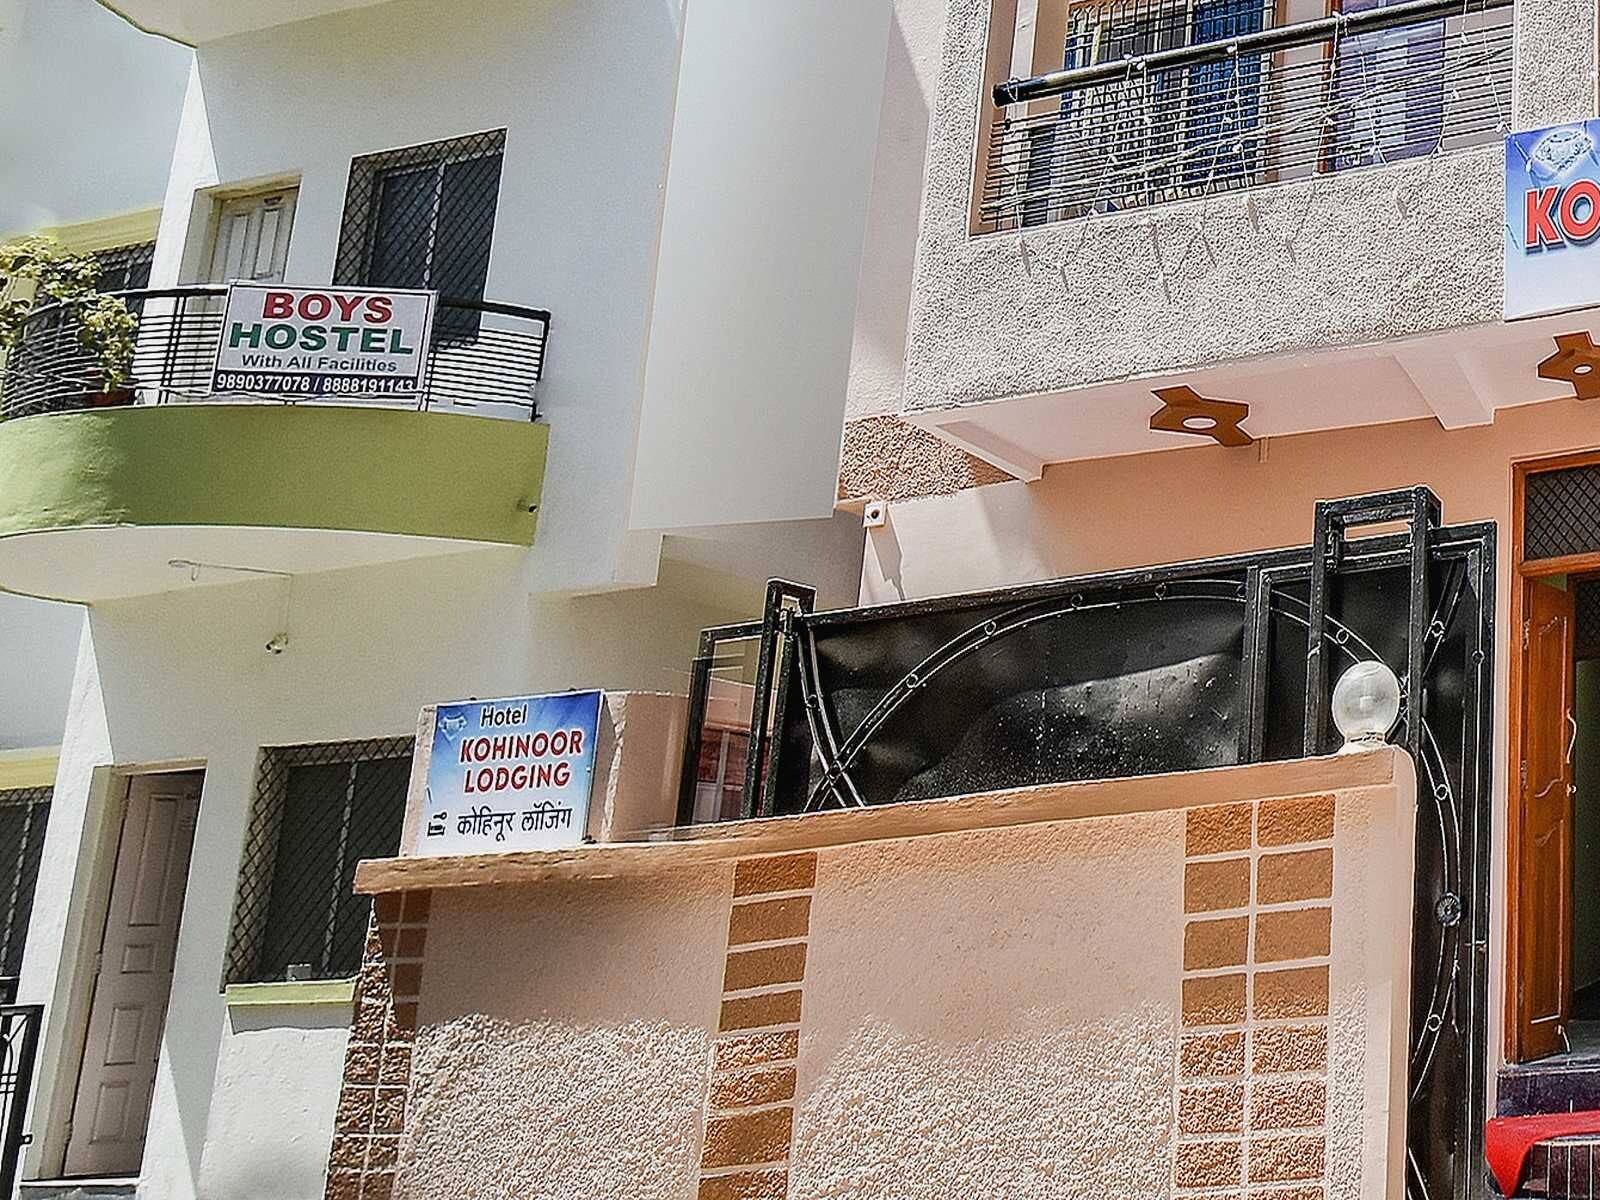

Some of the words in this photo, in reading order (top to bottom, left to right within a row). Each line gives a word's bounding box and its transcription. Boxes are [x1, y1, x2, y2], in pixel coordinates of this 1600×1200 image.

[262, 291, 393, 324] BOYS
[229, 322, 414, 355] HOSTEL
[241, 354, 282, 370] With
[287, 355, 312, 370] All
[318, 356, 397, 373] Facilities
[216, 373, 310, 392] 9890377078
[480, 704, 528, 728] Hotel
[460, 730, 584, 763] KOHINOOR
[464, 762, 572, 794] LODGING
[456, 806, 516, 842] कोहिनूर
[521, 800, 573, 832] लॉजिंग
